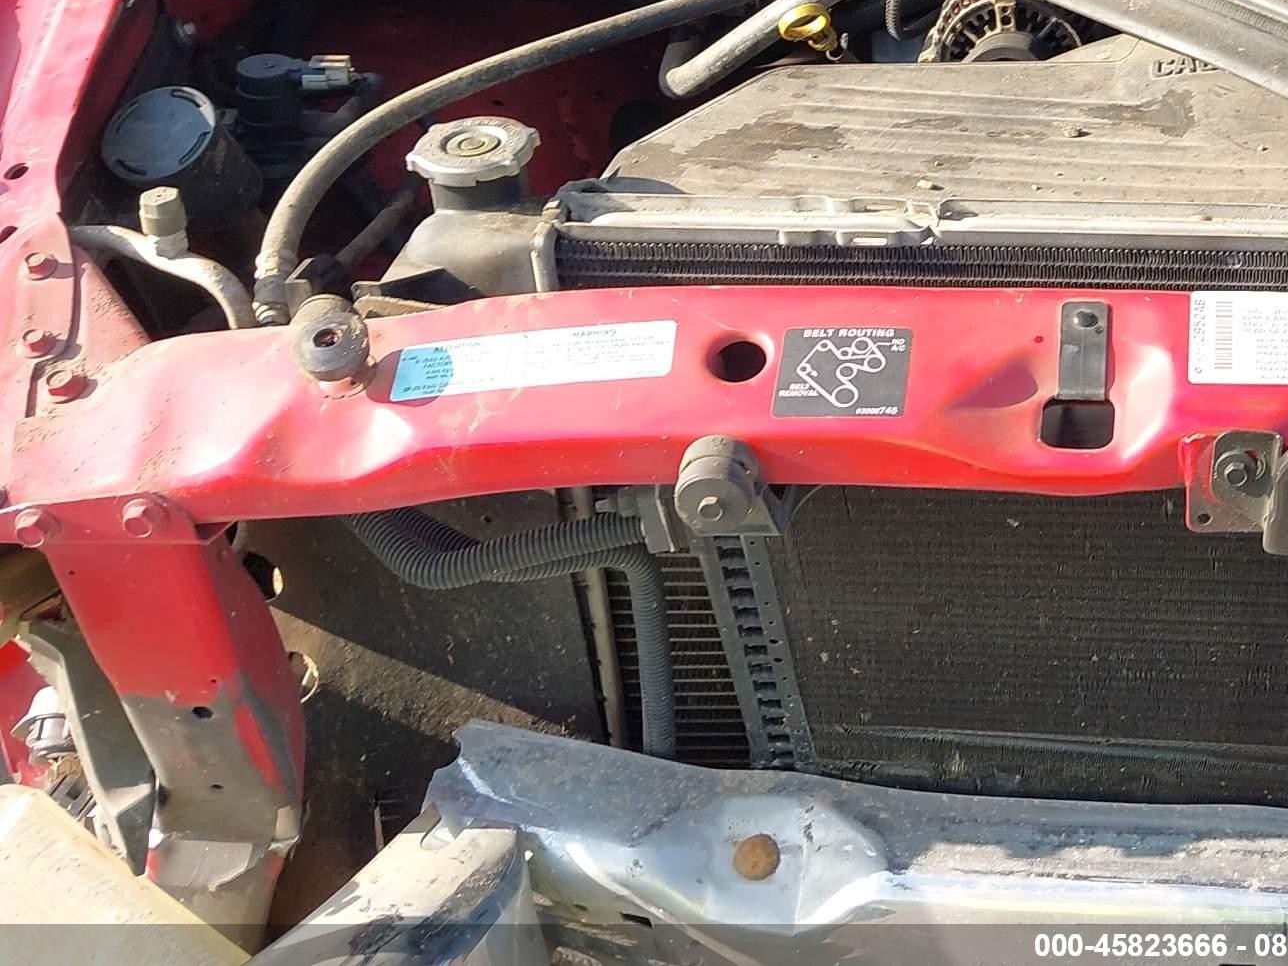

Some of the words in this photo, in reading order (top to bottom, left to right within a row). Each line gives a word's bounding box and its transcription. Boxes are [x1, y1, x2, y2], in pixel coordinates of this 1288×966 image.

[803, 328, 836, 339] BELT
[838, 328, 896, 339] ROUTING
[778, 389, 820, 397] REMOVAL
